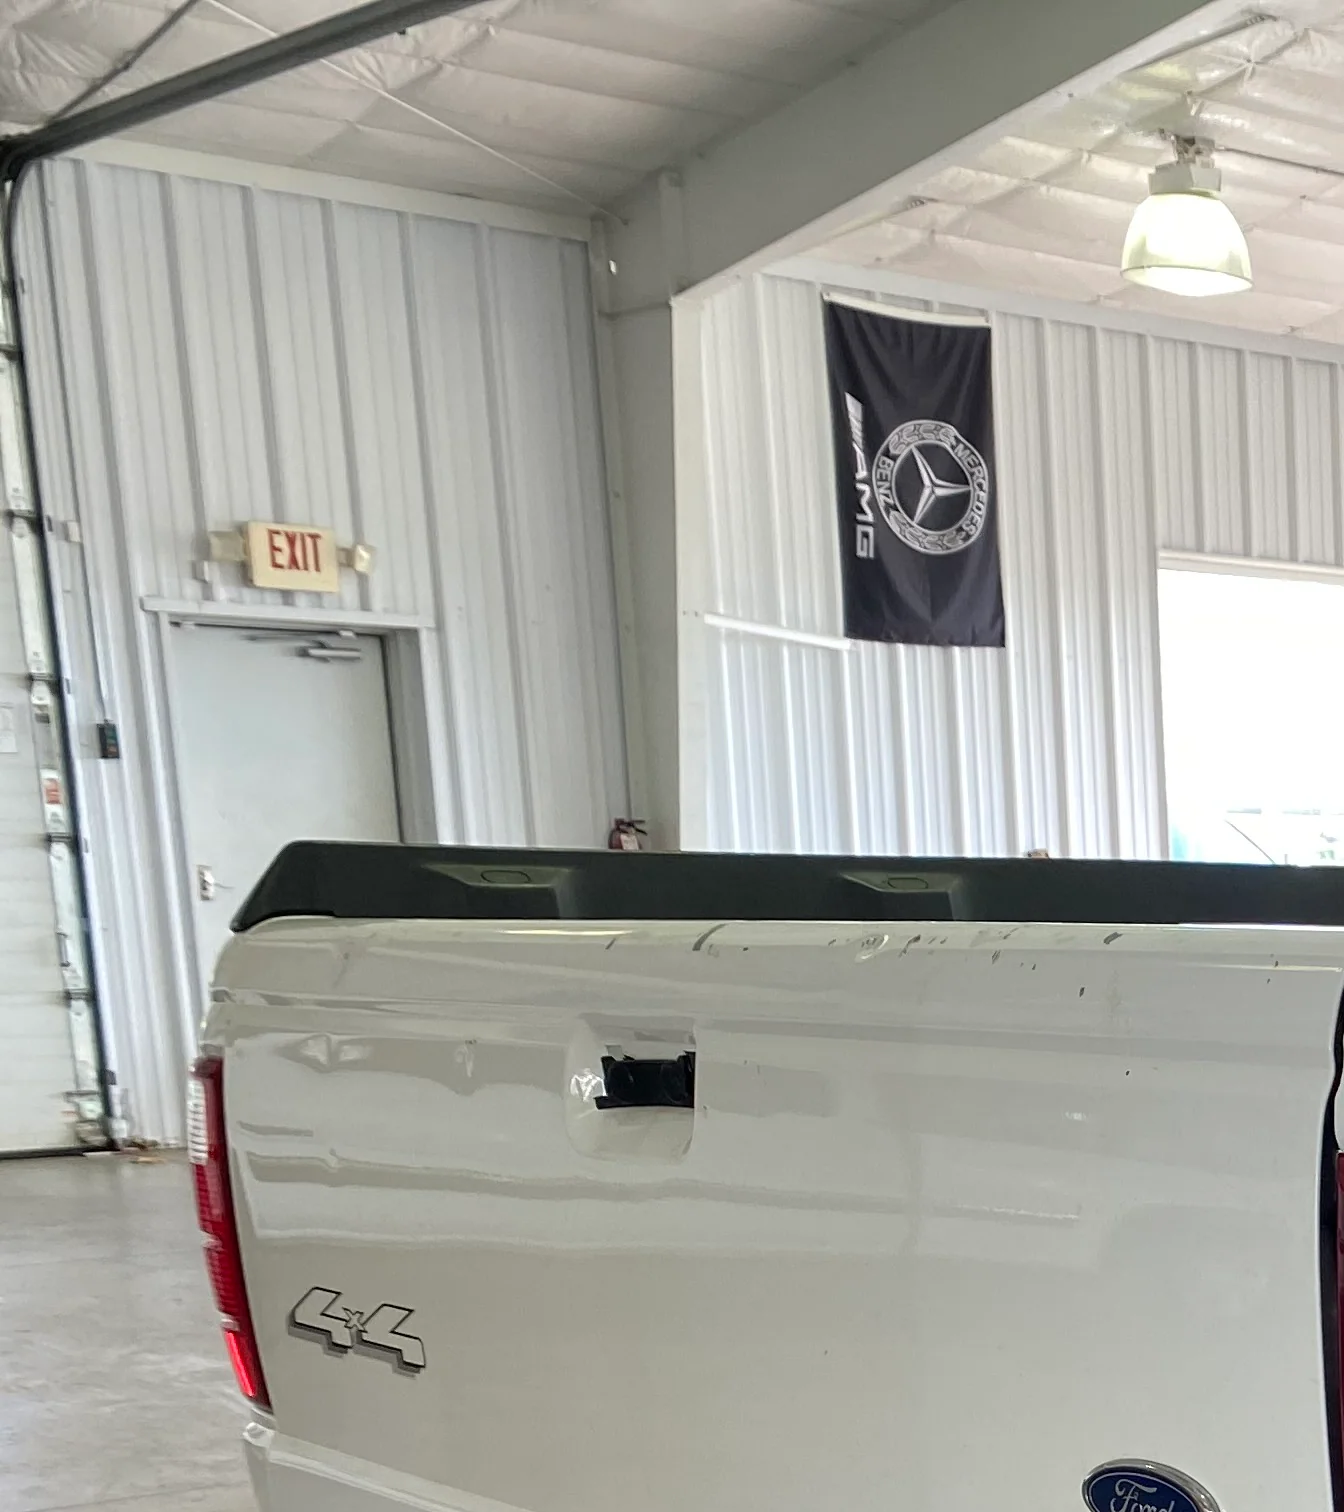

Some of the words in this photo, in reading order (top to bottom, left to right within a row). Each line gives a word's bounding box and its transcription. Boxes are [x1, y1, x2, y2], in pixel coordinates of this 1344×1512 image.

[852, 441, 875, 560] AMG
[876, 455, 897, 508] BENZ
[267, 528, 322, 573] EXIT
